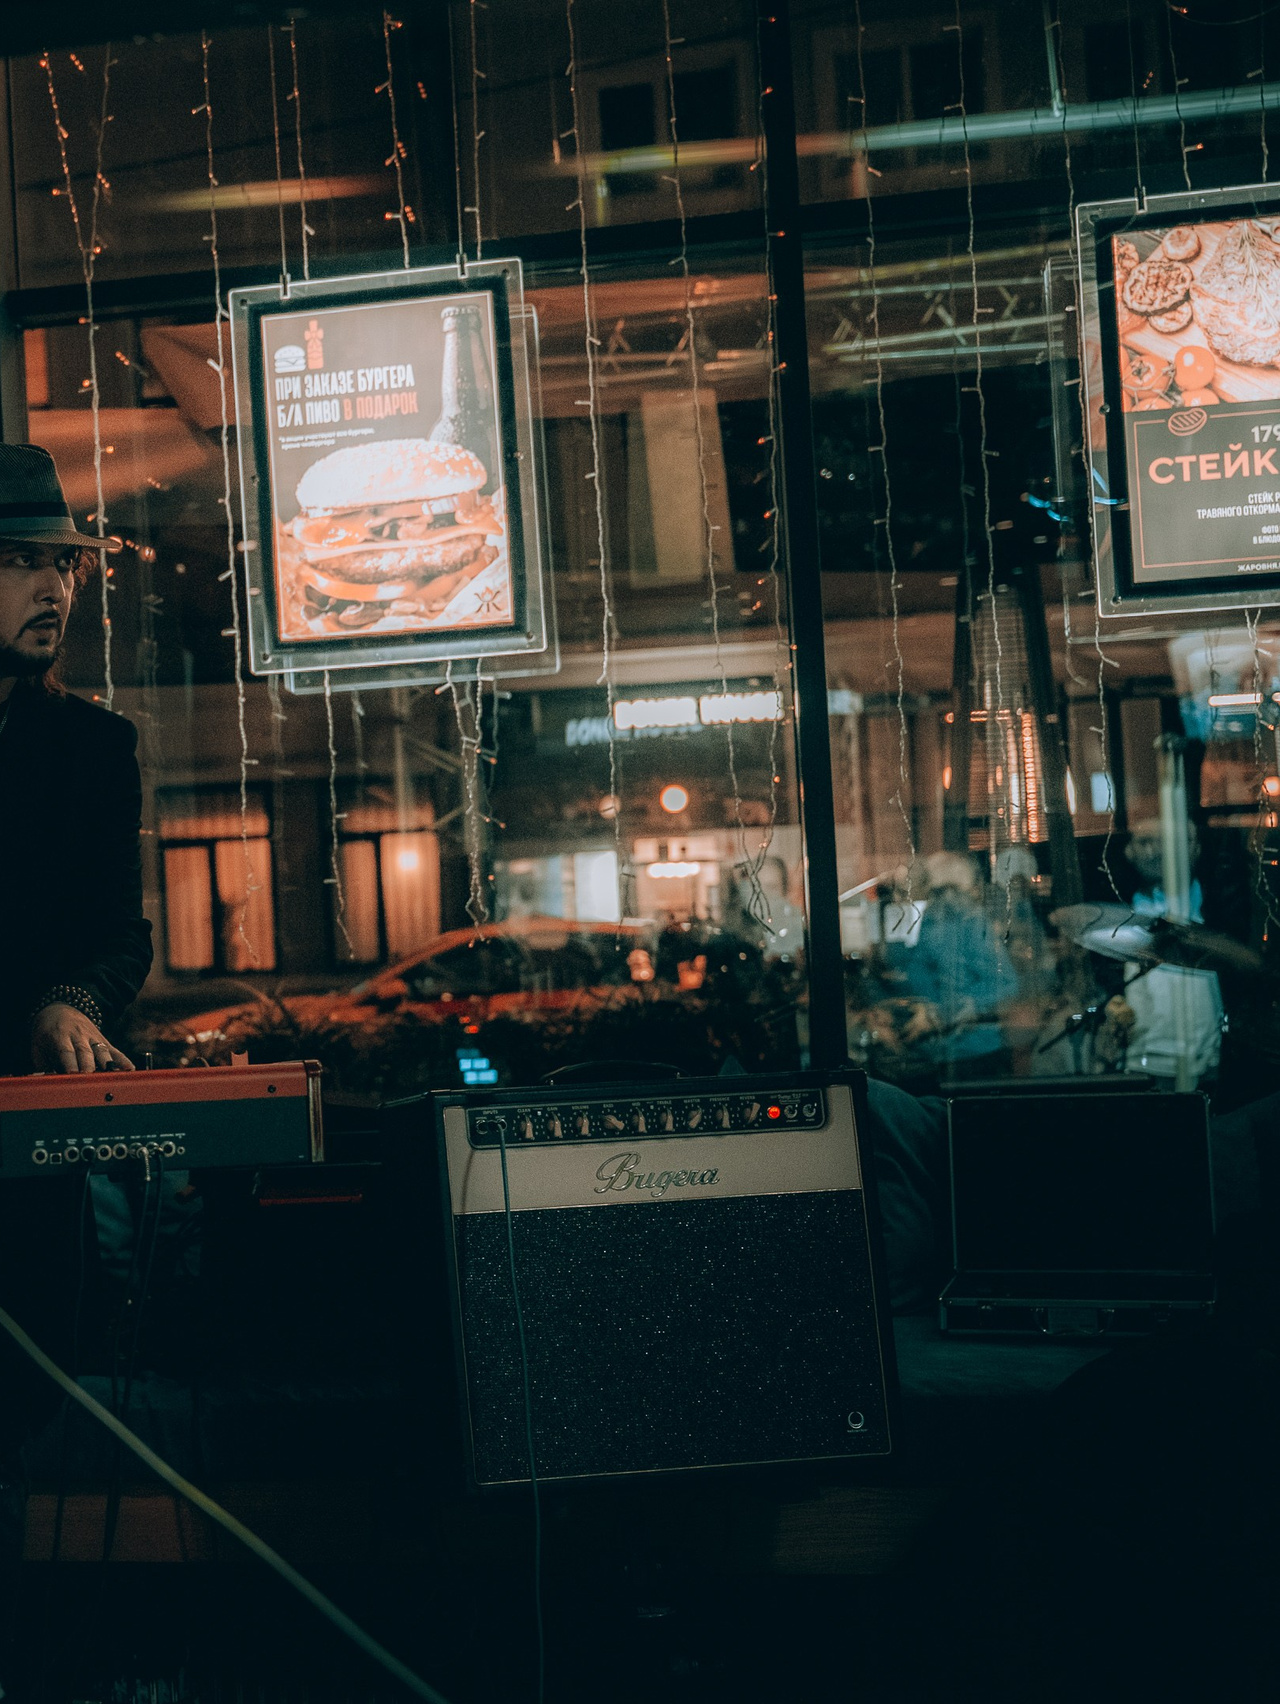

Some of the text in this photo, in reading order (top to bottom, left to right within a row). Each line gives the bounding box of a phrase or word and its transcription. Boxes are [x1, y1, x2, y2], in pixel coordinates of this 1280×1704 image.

[275, 364, 416, 401] ПРИ ЗАКАЗЕ БУРГЕРА
[277, 391, 419, 428] Б/А ПИВО В ПОДАРОК
[1148, 443, 1279, 484] СТЕЙК
[1196, 505, 1242, 519] ТРАВЯНОГО
[1248, 491, 1274, 504] СТЕЙК
[594, 1152, 720, 1197] Bugera
